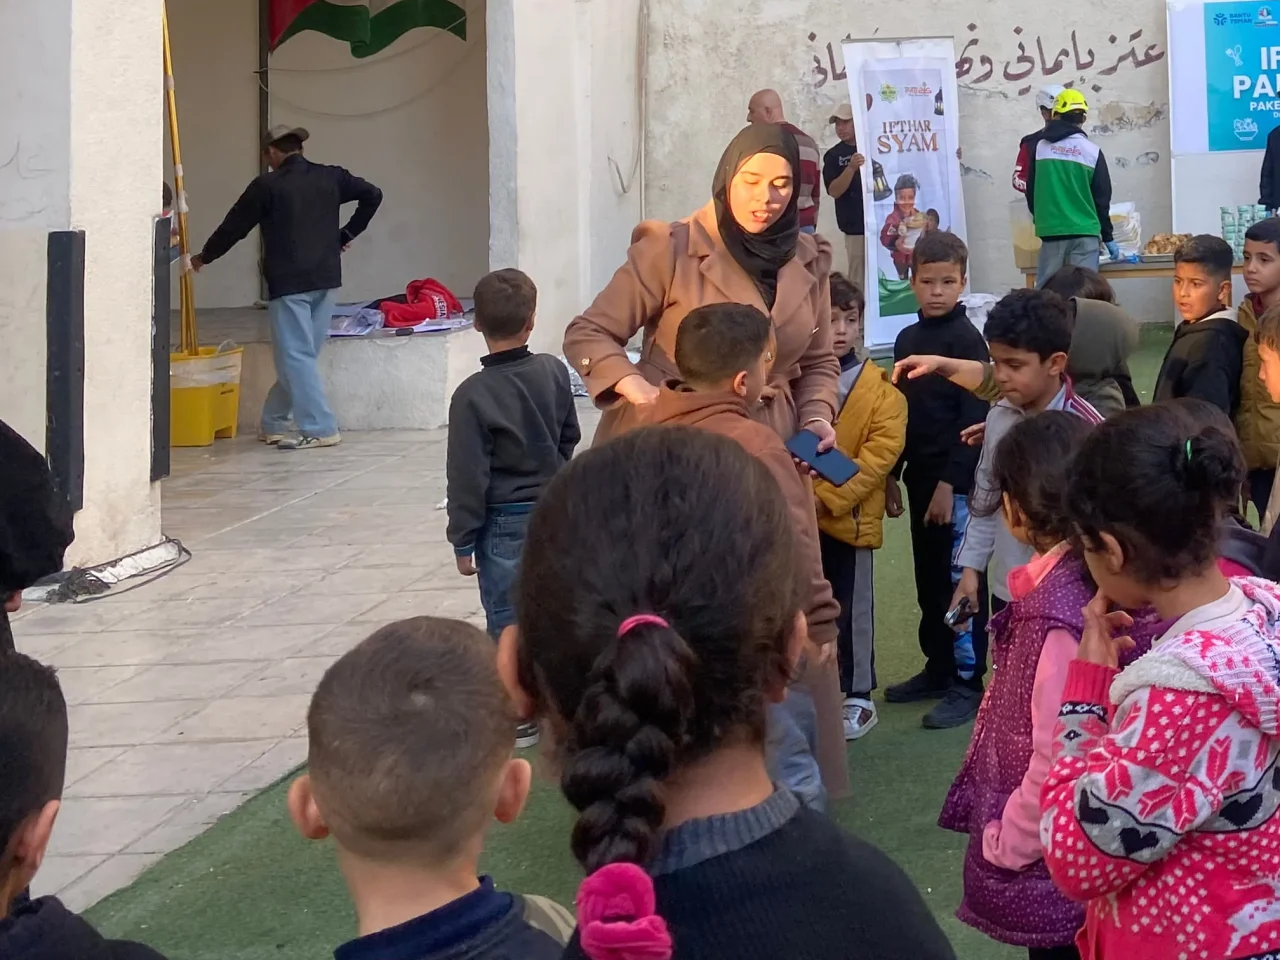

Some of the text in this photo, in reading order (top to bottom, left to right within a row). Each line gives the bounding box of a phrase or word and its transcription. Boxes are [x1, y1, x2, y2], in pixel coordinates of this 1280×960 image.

[1250, 100, 1280, 111] PAKE
[882, 120, 932, 134] IFTHAR
[877, 133, 939, 154] SYAM
